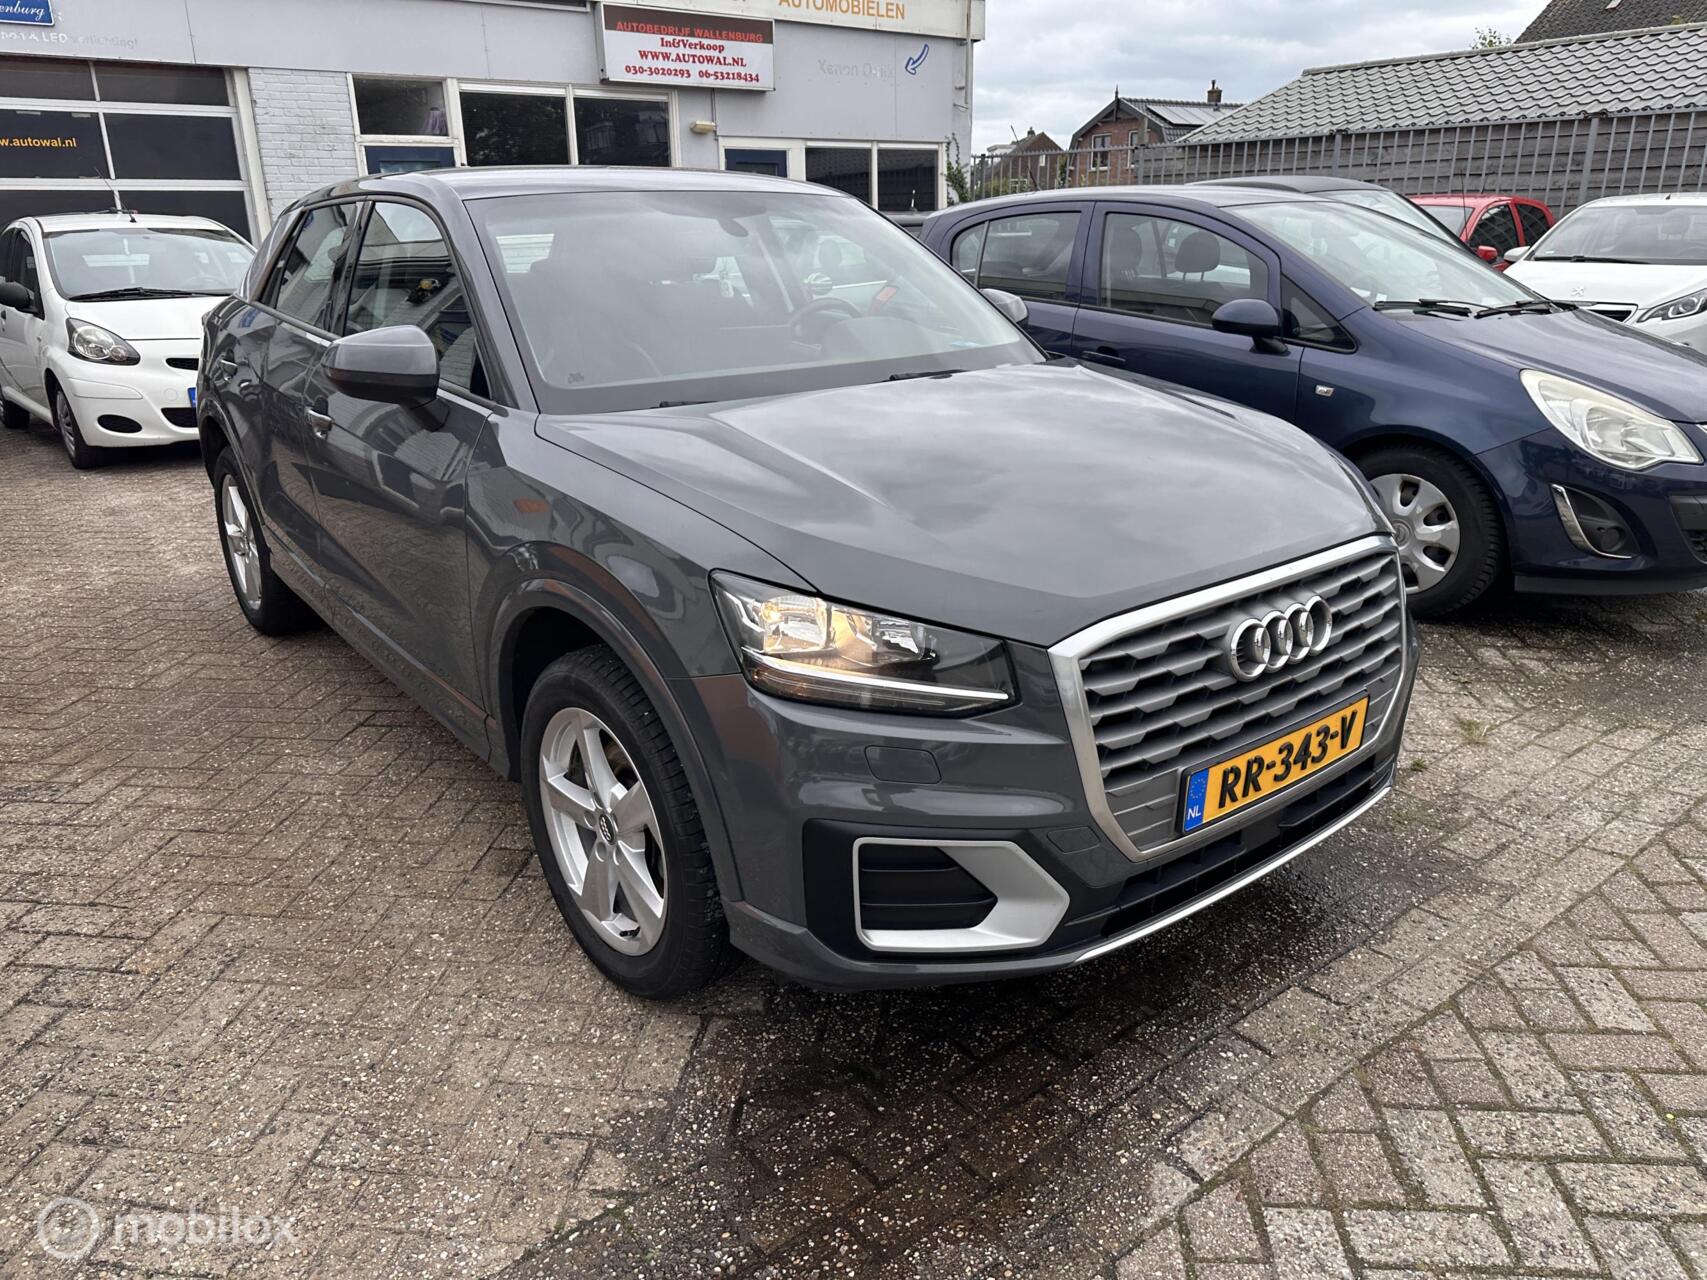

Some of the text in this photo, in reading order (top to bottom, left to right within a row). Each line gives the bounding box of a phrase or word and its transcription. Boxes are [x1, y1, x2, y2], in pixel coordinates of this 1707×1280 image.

[42, 32, 68, 43] LED
[616, 21, 763, 42] AUTOBEDRIJF WALLENBURG
[661, 37, 725, 53] In&Verkoop
[638, 50, 747, 67] WWW.AUTOWAL.NL
[624, 65, 760, 83] 030-3020293 06-53218434
[1218, 708, 1358, 809] RR-343-V
[1187, 805, 1201, 820] NL
